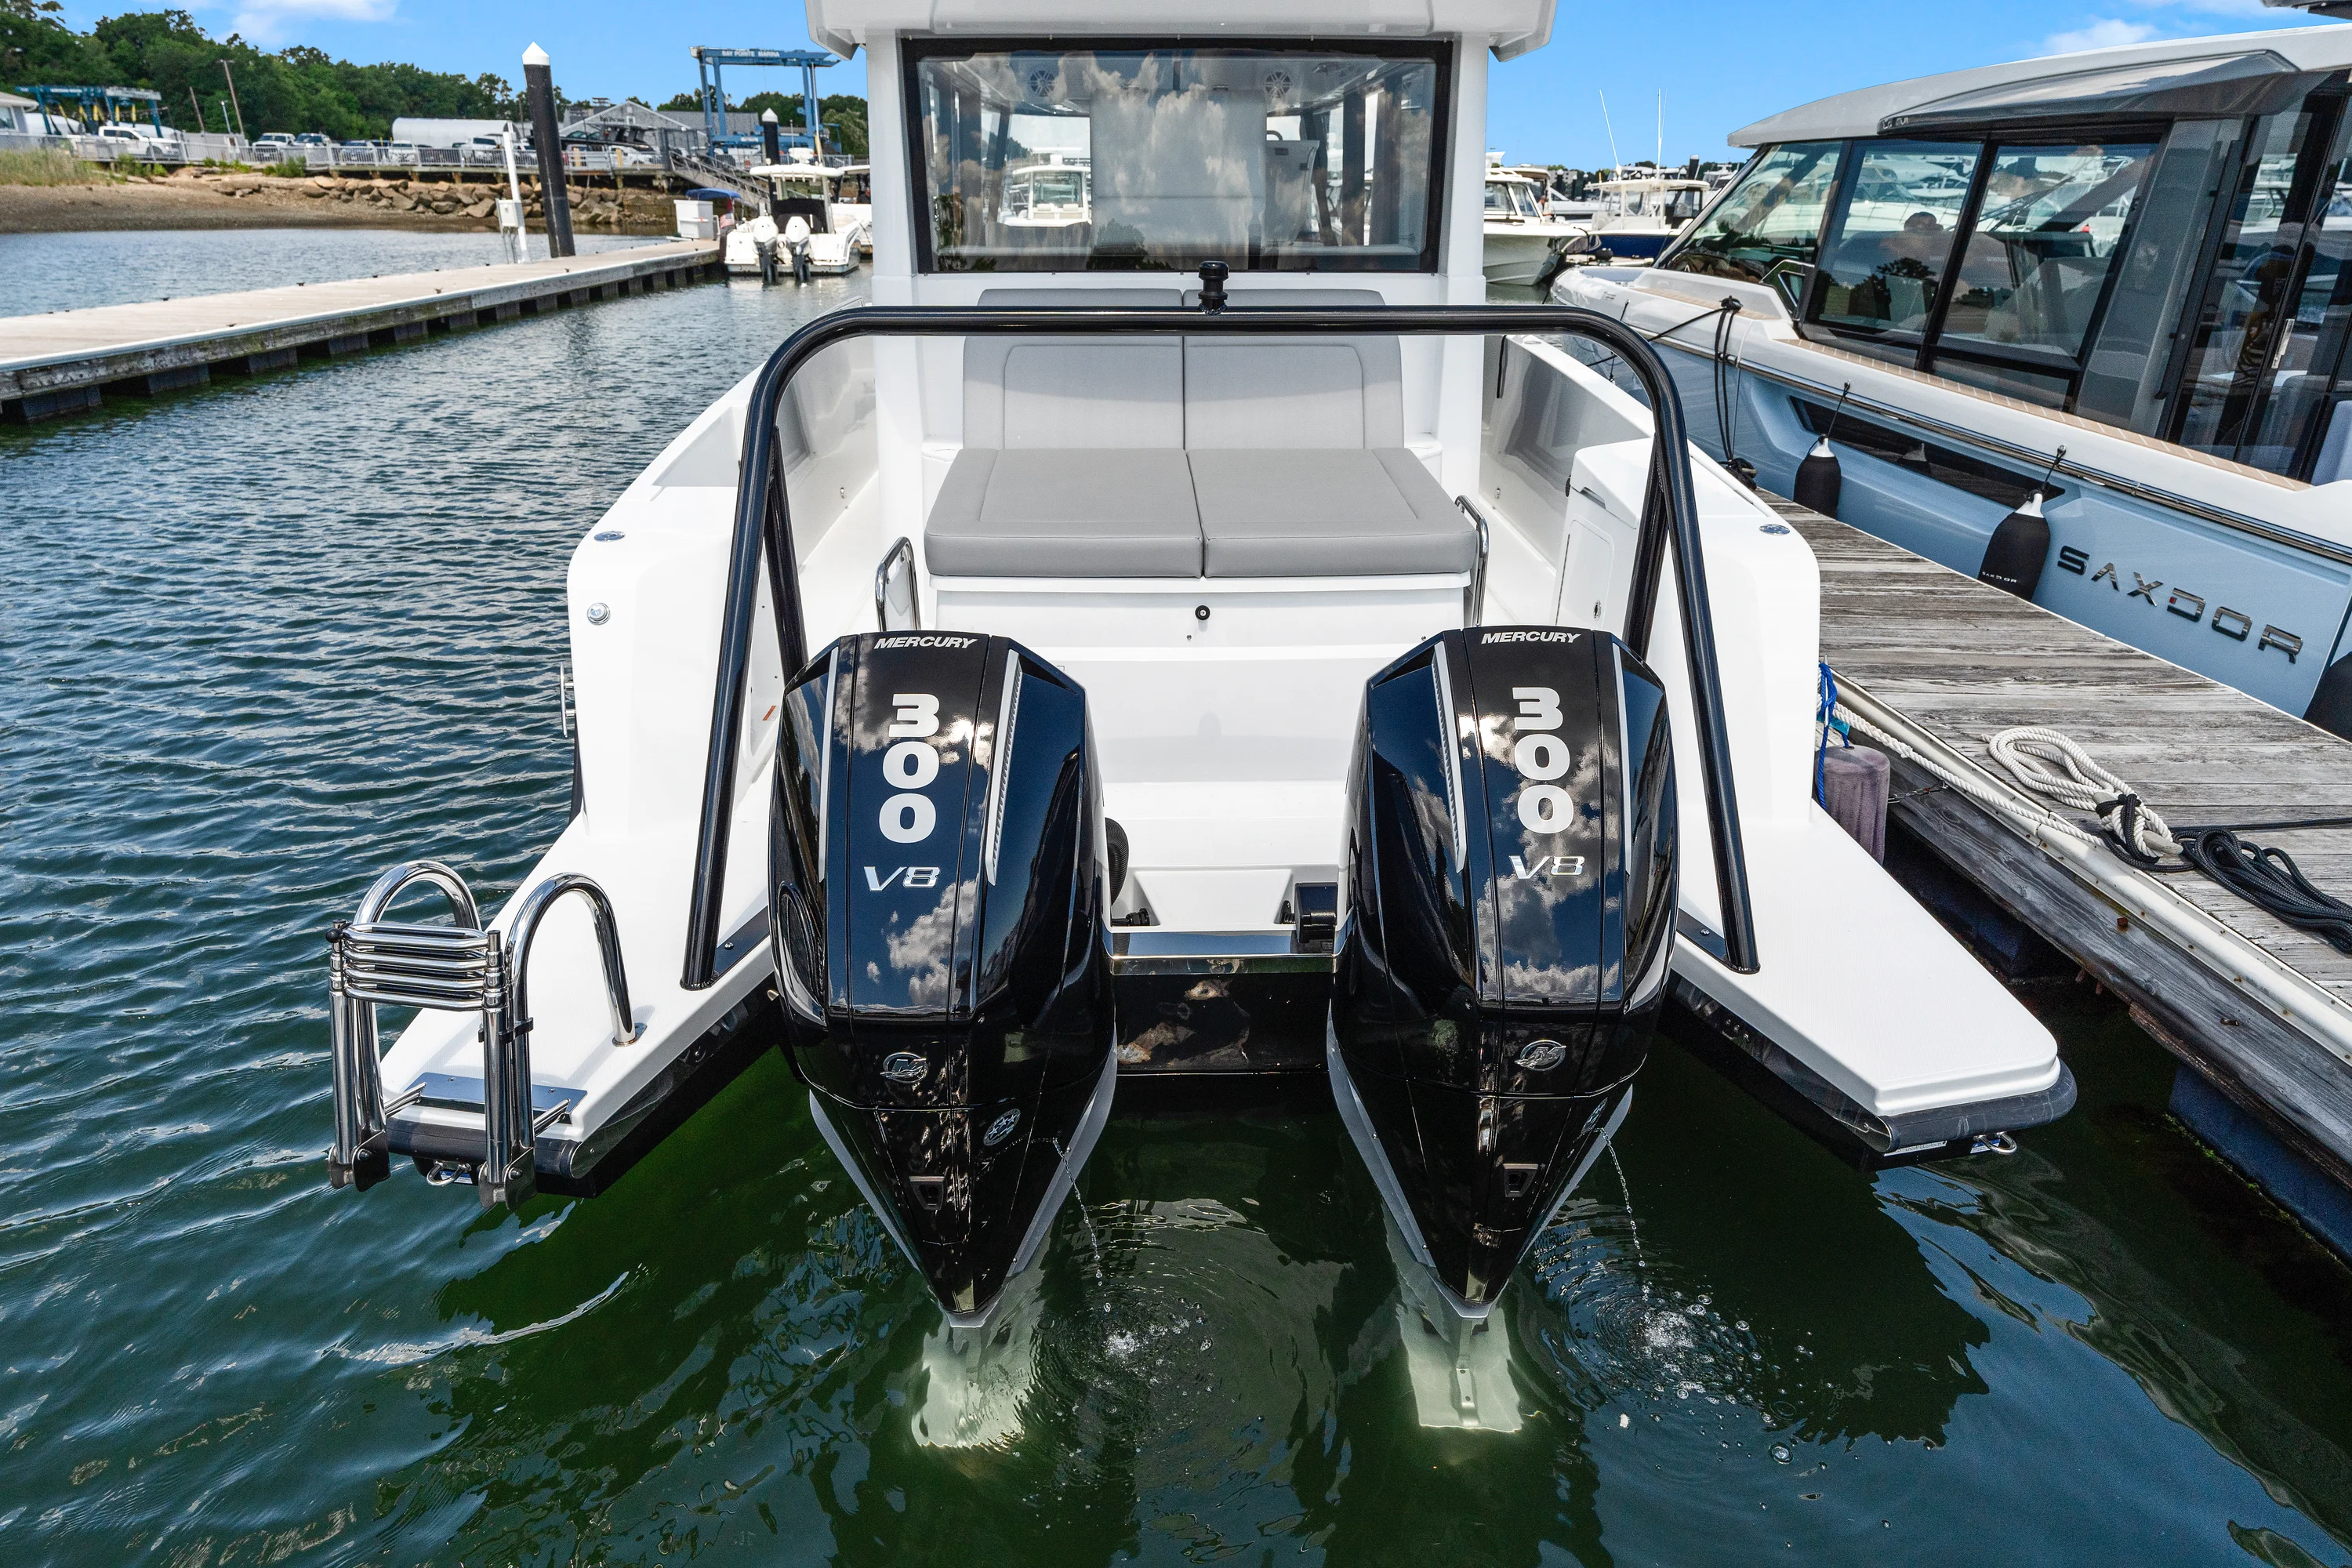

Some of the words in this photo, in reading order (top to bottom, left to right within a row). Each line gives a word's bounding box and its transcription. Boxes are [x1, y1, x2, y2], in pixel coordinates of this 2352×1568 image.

[2057, 545, 2303, 664] SAXDOR
[873, 636, 978, 649] MERCURY
[1481, 631, 1581, 644] MERCURY
[879, 693, 940, 844] 300
[1512, 686, 1574, 834] 300
[863, 866, 941, 892] V8
[1508, 855, 1585, 880] V8
